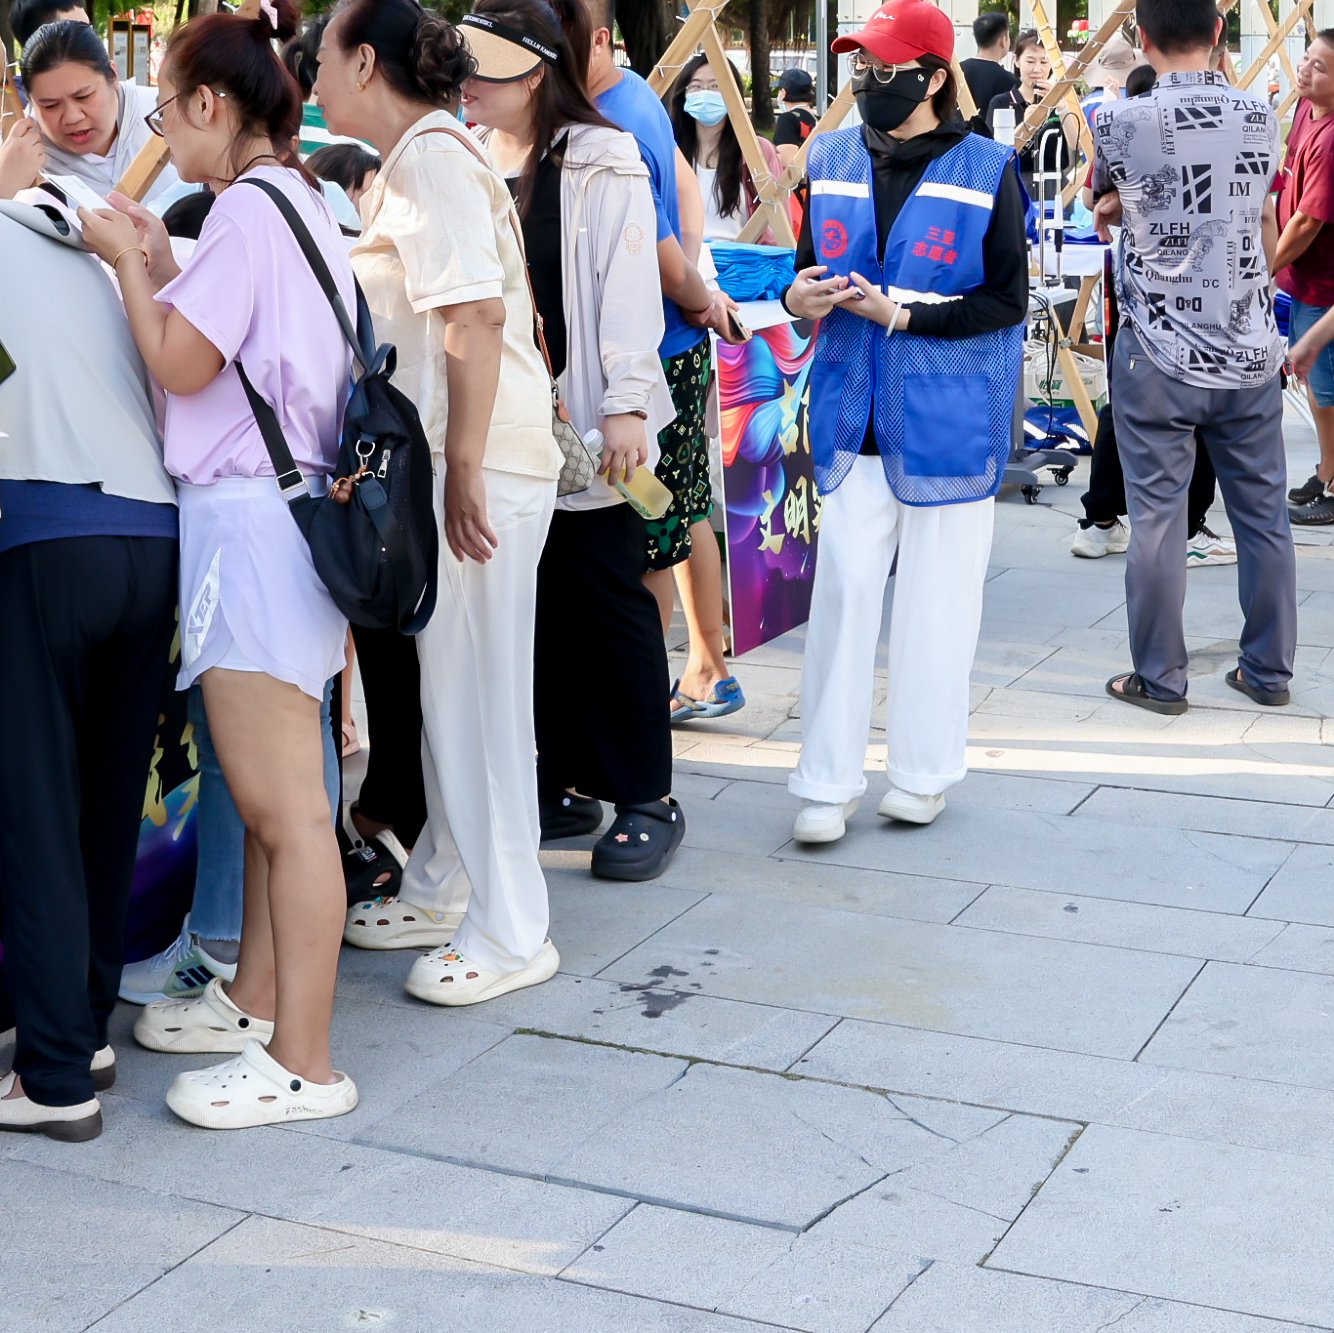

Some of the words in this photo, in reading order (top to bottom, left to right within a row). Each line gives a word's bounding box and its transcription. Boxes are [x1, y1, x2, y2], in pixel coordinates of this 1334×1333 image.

[1228, 181, 1251, 197] IM
[925, 225, 956, 245] 三亚
[1149, 222, 1190, 235] ZLFH
[911, 241, 959, 265] 志愿者
[1145, 269, 1193, 285] Qilanghu
